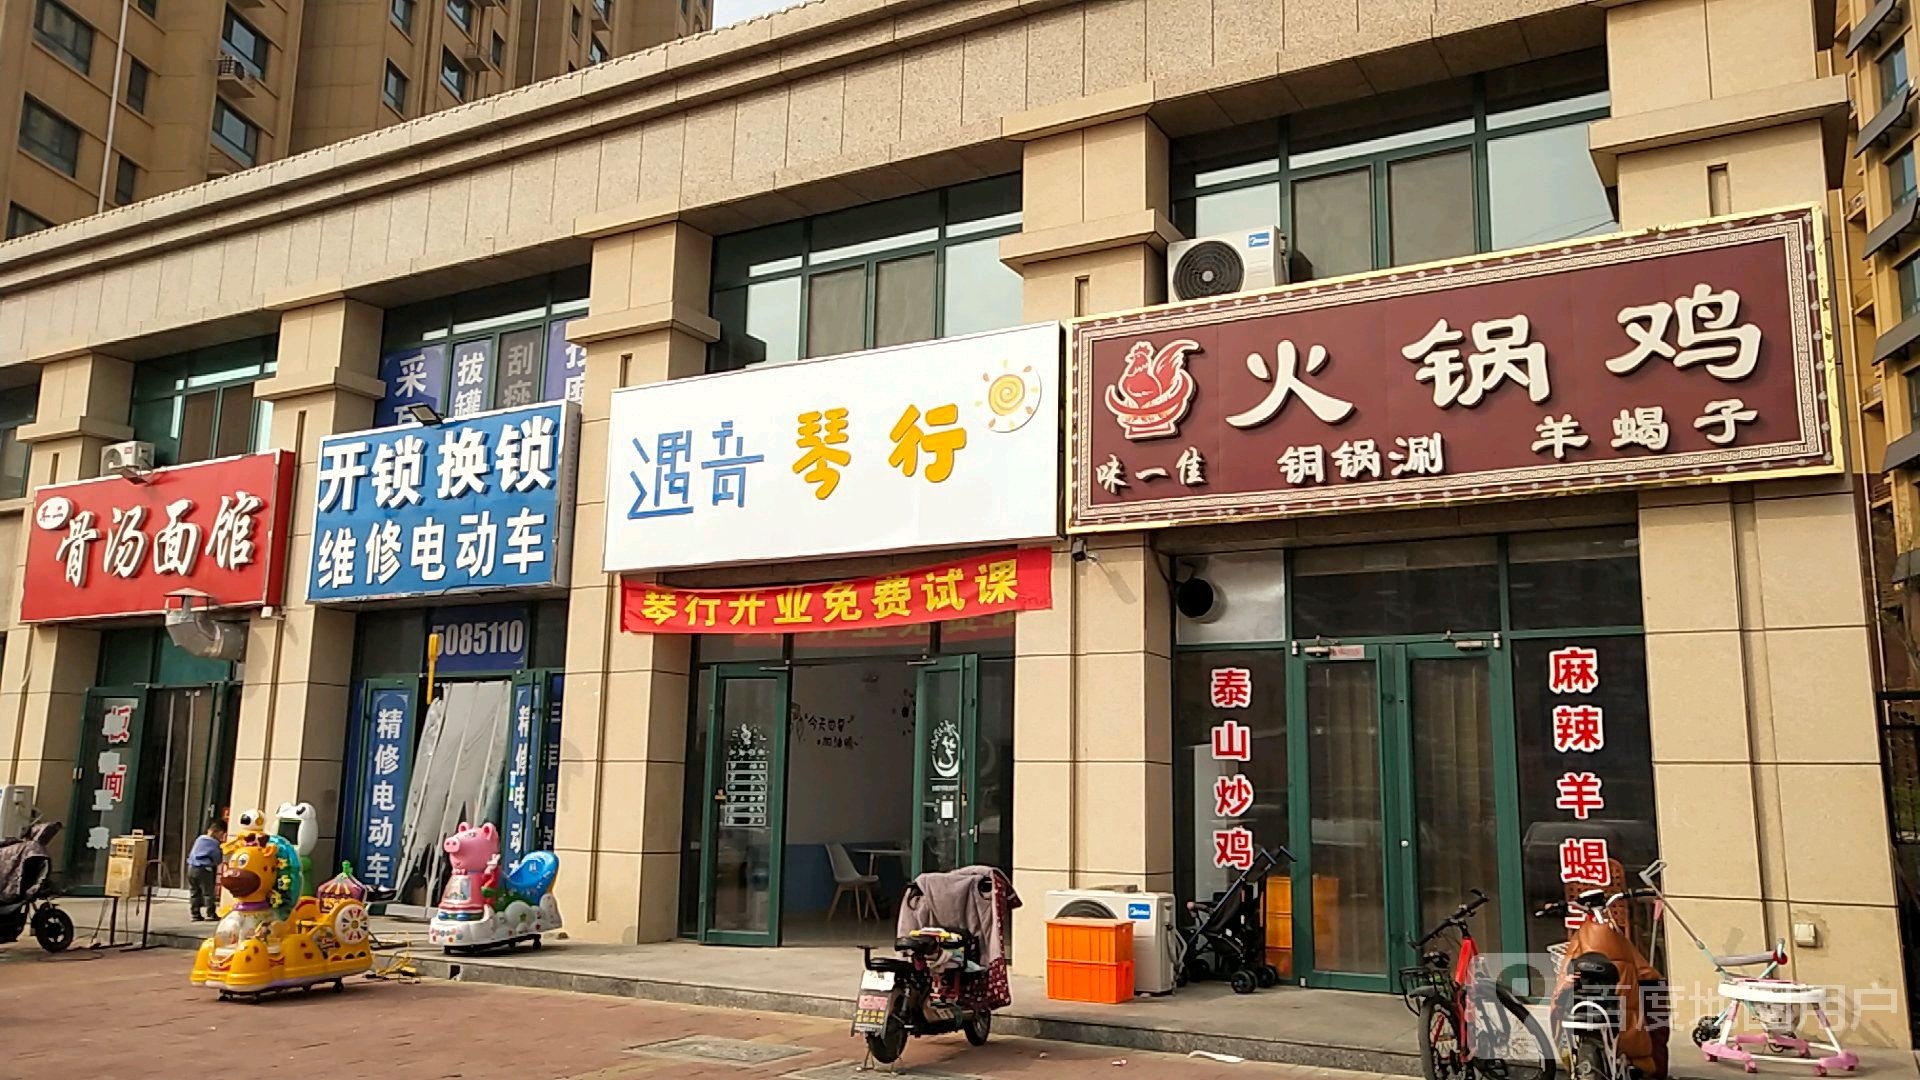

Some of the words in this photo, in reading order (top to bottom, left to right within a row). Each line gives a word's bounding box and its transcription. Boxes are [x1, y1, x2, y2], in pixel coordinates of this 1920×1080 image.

[454, 351, 486, 416] 拔罐
[1225, 284, 1762, 428] 火锅鸡
[318, 415, 556, 513] 开锁换锁
[627, 403, 967, 520] 遇音琴行
[1095, 446, 1207, 495] 味一佳
[1277, 432, 1444, 485] 铜锅涮
[1531, 398, 1758, 459] 羊蝎子
[56, 491, 263, 588] 骨汤面馆
[317, 507, 546, 589] 维修电动车
[641, 558, 1020, 627] 琴行开业免费试课
[364, 708, 403, 886] 精修电动车
[1211, 667, 1254, 870] 泰山炒鸡
